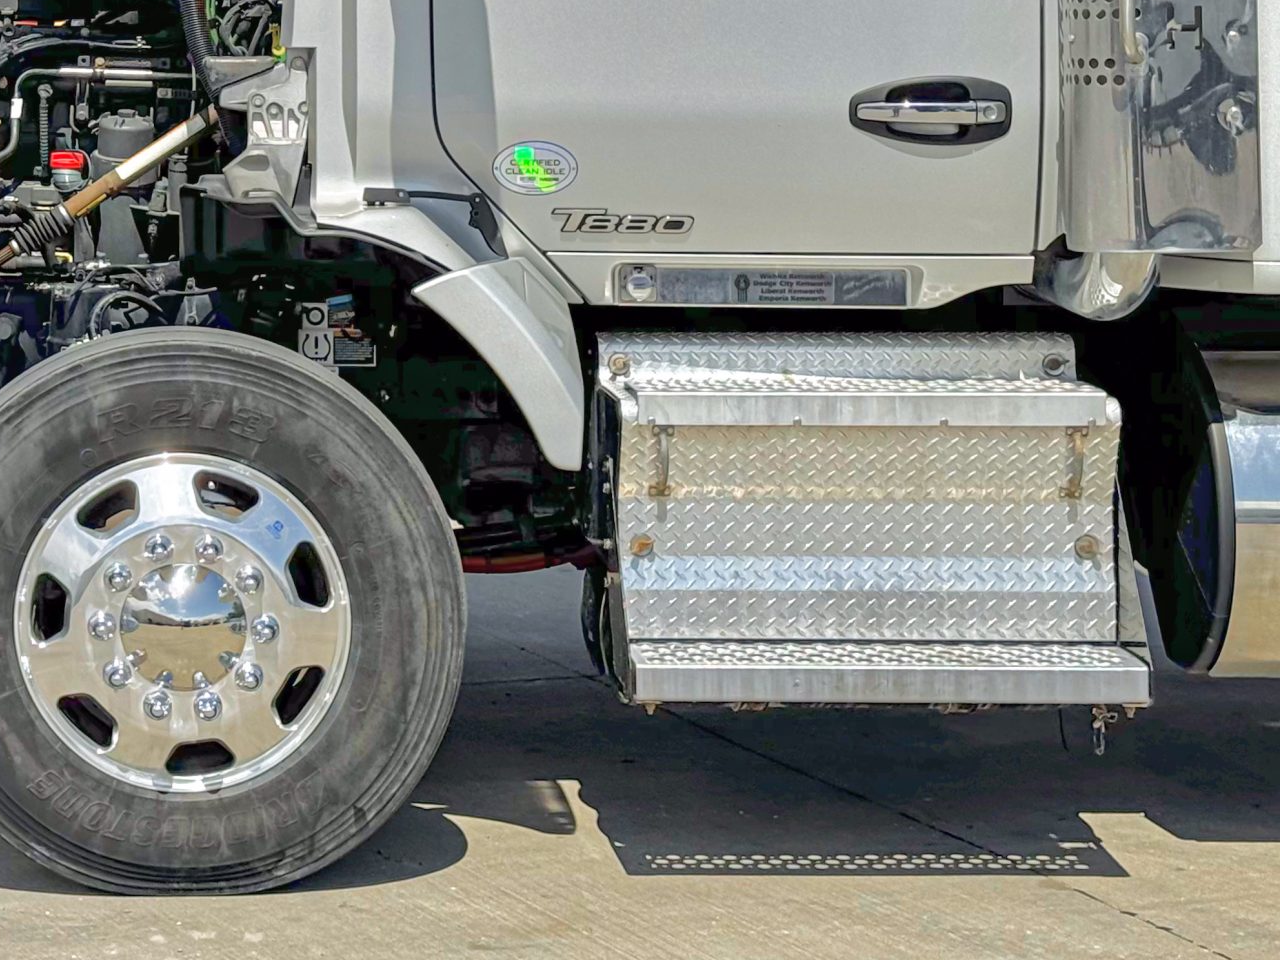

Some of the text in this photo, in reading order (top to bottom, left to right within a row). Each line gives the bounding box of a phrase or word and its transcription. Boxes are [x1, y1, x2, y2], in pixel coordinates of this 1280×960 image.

[509, 159, 561, 167] CERTIFIED
[551, 207, 695, 235] T880
[95, 396, 278, 444] R213
[25, 768, 328, 848] BRIDGESTONE
